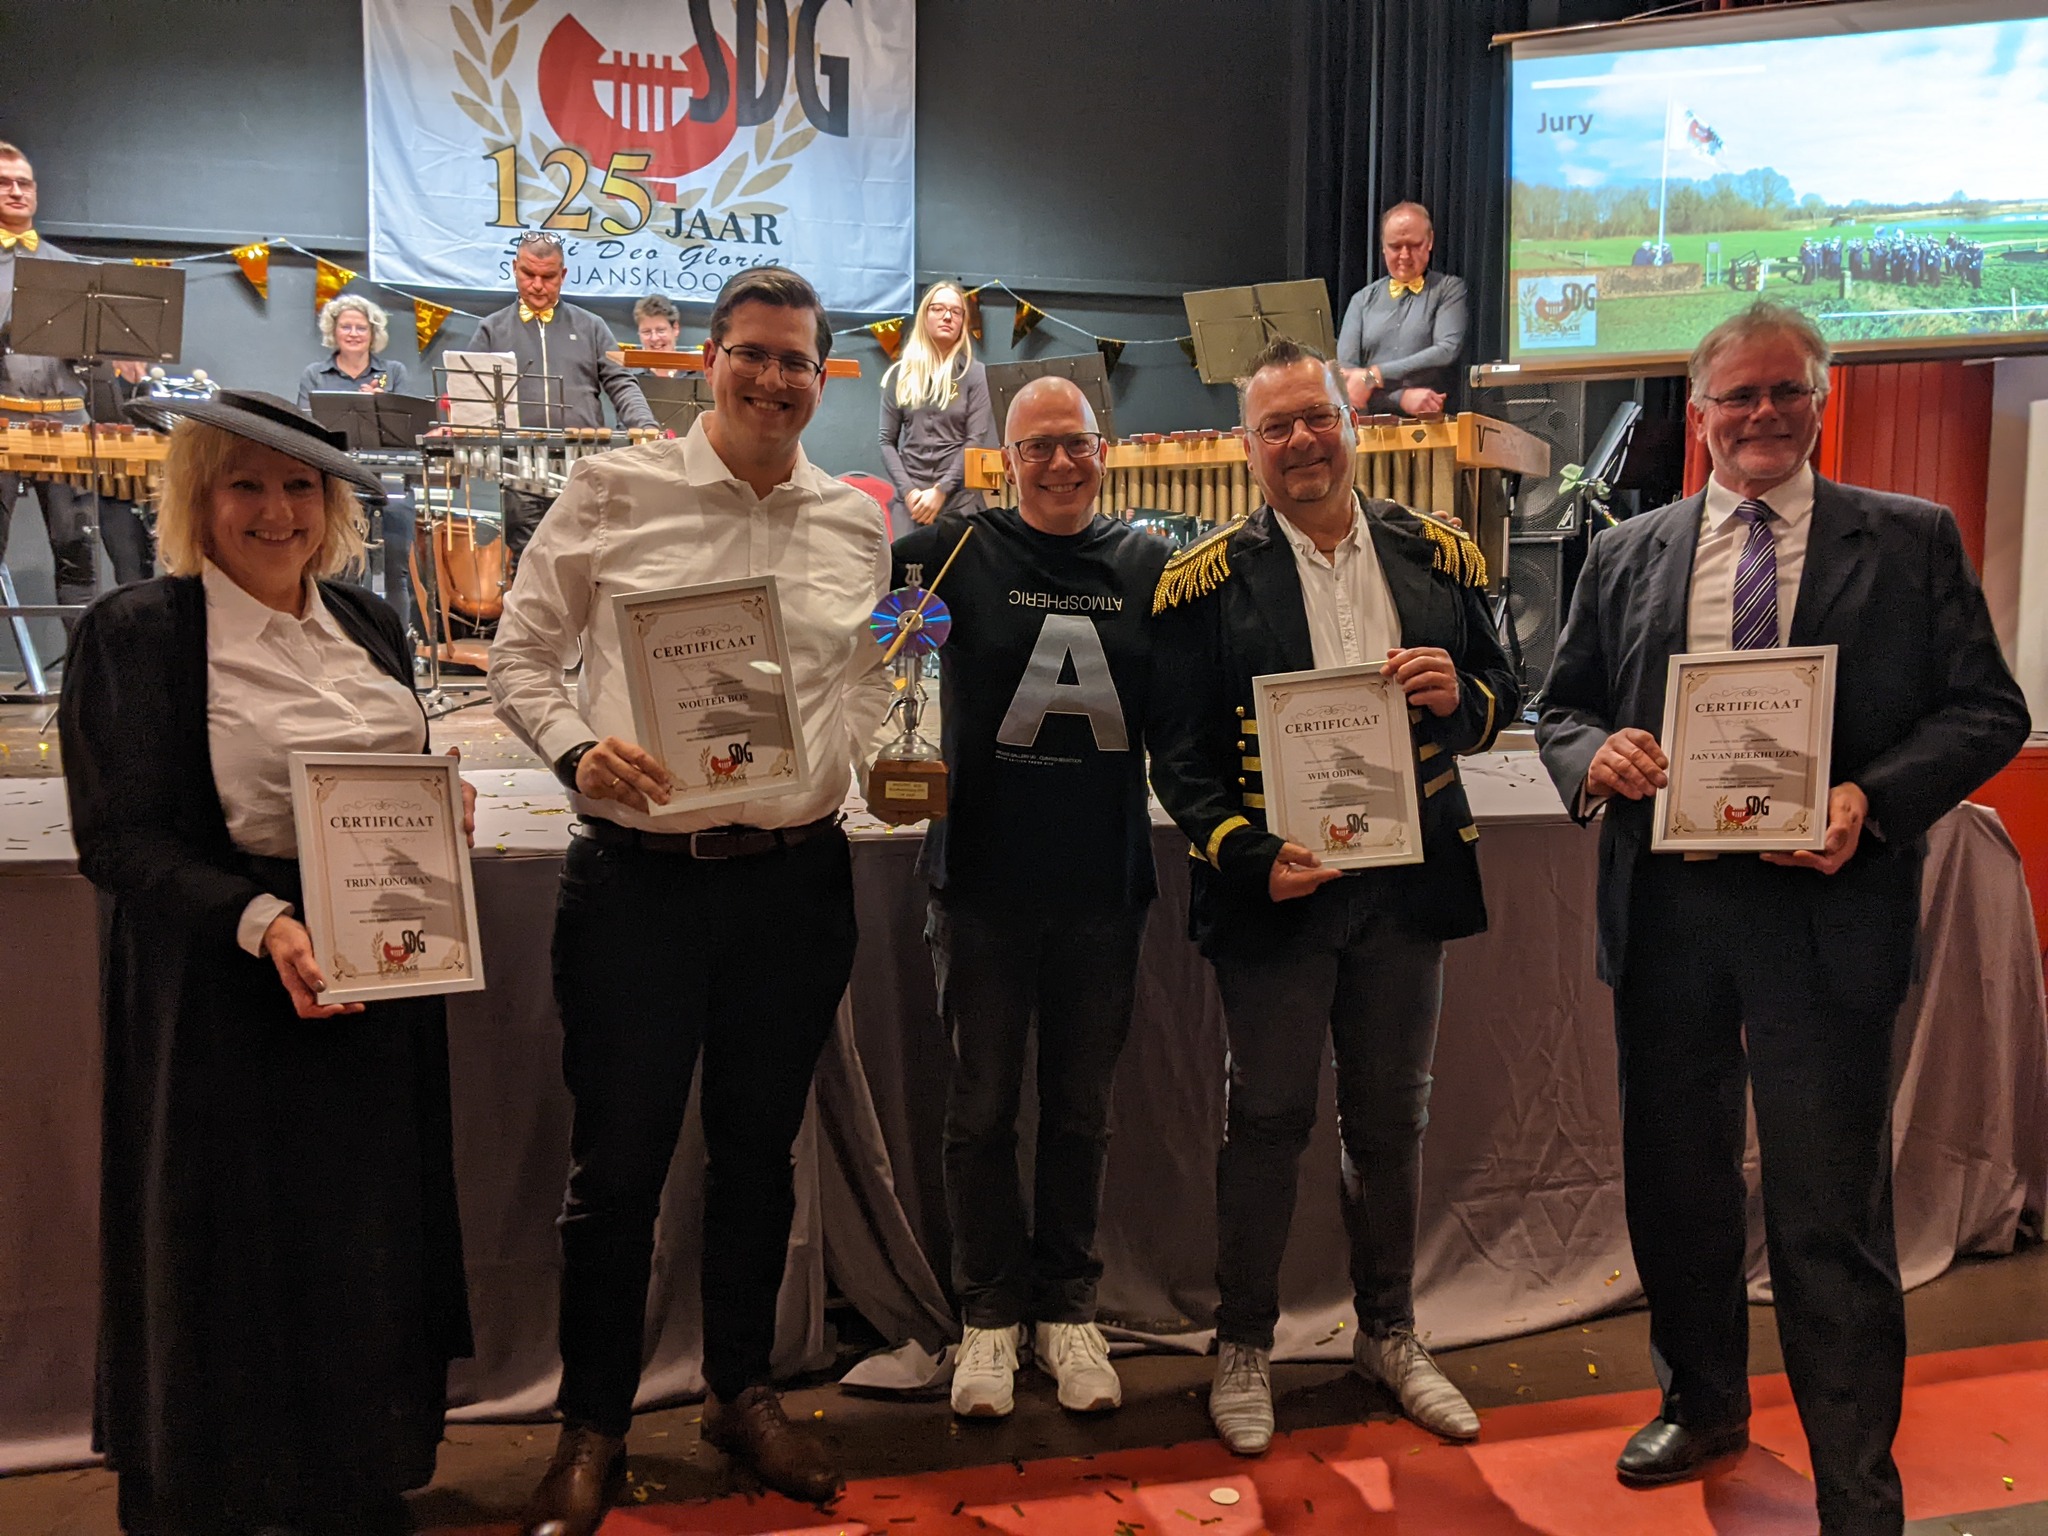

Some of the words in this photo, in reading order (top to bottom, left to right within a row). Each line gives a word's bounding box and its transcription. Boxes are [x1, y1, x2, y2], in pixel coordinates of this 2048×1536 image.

[688, 0, 853, 137] SDG
[1536, 111, 1594, 135] Jury
[482, 144, 653, 235] 125
[665, 207, 782, 246] JAAR
[596, 239, 659, 260] Deo
[1562, 283, 1596, 311] SDG
[1008, 589, 1124, 612] ATMOSPHERIC
[652, 634, 758, 659] CERTIFICAAT
[996, 613, 1130, 751] A
[678, 696, 726, 710] WOUTER
[728, 692, 749, 703] BOS
[1695, 698, 1803, 713] CERTIFICAAT
[1284, 714, 1381, 734] CERTIFICAAT
[728, 741, 754, 766] SDG
[1711, 752, 1732, 760] VAN
[1734, 750, 1799, 759] BEEKHUIZEN
[1307, 771, 1330, 780] WIM
[1332, 768, 1365, 779] ODINK
[1745, 795, 1771, 816] SDG
[330, 815, 435, 828] CERTIFICAAT
[1346, 812, 1369, 833] SDG
[344, 878, 377, 888] TRIJN
[379, 875, 432, 887] JONGMAN
[402, 929, 426, 954] SDG
